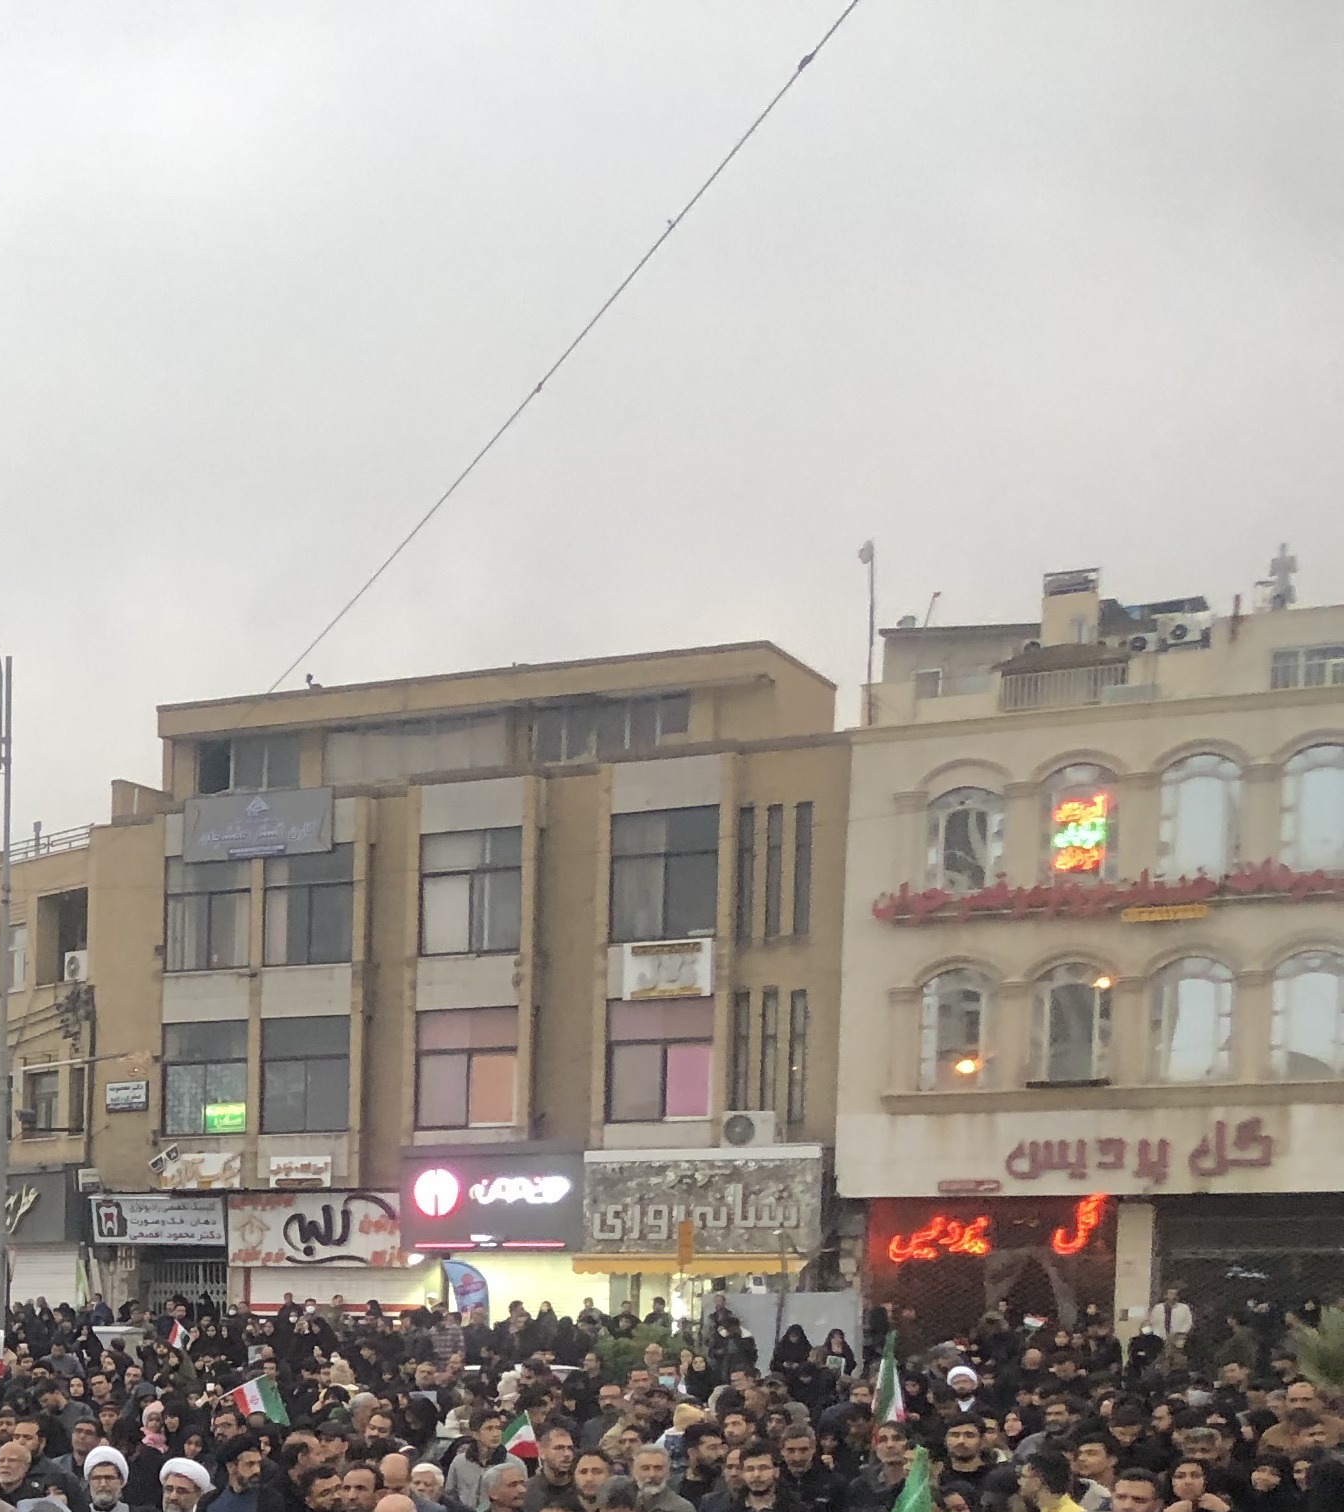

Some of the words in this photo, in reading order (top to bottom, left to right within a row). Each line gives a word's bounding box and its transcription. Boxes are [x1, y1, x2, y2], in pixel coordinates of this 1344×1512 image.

[1005, 1137, 1170, 1184] پردیس
[1189, 1116, 1275, 1177] گل
[166, 1231, 195, 1242] محمود
[196, 1230, 222, 1242] دکتر
[888, 1215, 991, 1263] پردیس
[1052, 1192, 1109, 1255] گل
